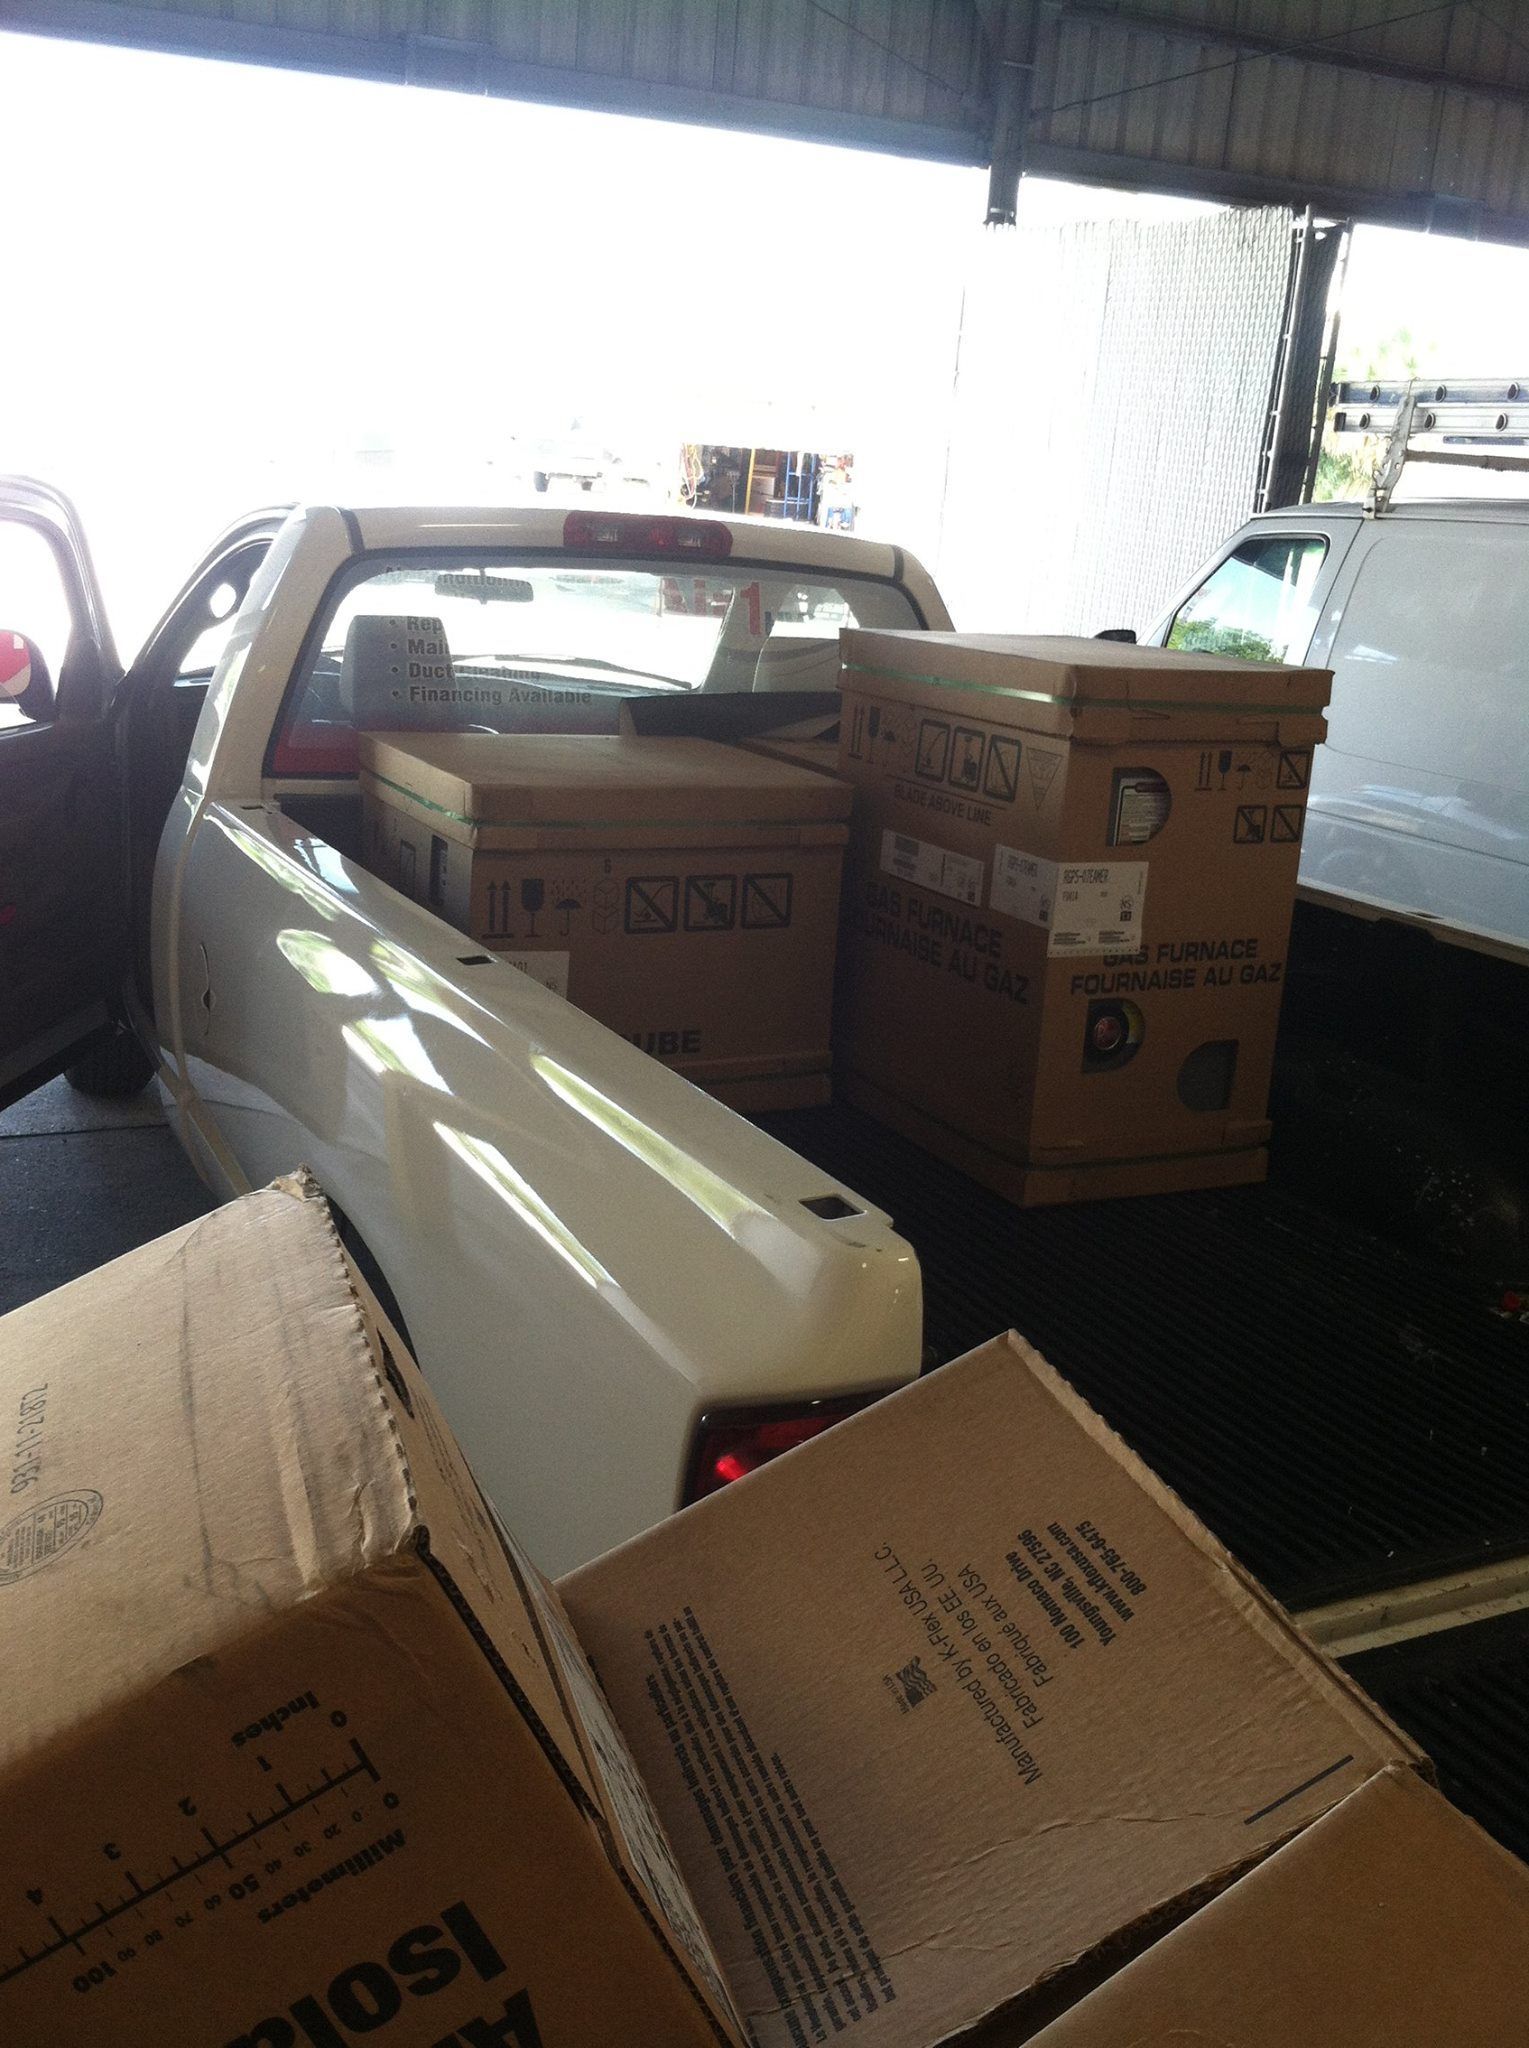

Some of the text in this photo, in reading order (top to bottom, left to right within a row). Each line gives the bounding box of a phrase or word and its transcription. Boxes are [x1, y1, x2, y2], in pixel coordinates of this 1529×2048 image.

[408, 663, 454, 679] Duct
[409, 686, 592, 706] Financing Available
[927, 794, 965, 817] ABOVE
[966, 806, 994, 827] LINE
[864, 880, 1003, 959] GAS FURNACE
[1156, 938, 1258, 964] FURNACE
[947, 948, 978, 983] AU
[983, 962, 1031, 1006] GAZ
[1071, 962, 1283, 995] FOURNAISE AU GAZ
[1045, 1520, 1135, 1623] www.kflexusa.com
[1074, 1518, 1147, 1597] 800-765-6475
[896, 1579, 929, 1617] USA
[1001, 1549, 1086, 1651] 100 Nomaco Drive
[1016, 1527, 1118, 1646] Youngsville, NC 27596
[916, 1611, 959, 1662] K-Flex
[916, 1556, 1044, 1729] Fabricado en los EE. UU.
[954, 1562, 1057, 1688] Fabriqué aux USA
[947, 1654, 977, 1683] by
[228, 1689, 320, 1754] Inches
[959, 1677, 1044, 1786] Manufactured
[24, 1709, 347, 1907] 0 1 2 3 4
[382, 1791, 400, 1809] 0
[292, 1840, 313, 1859] 30
[321, 1822, 342, 1842] 20
[255, 1827, 408, 1928] Millimeters
[262, 1856, 284, 1876] 40
[202, 1892, 223, 1912] 60
[226, 1872, 260, 1902] 50
[173, 1910, 194, 1929] 70
[115, 1944, 136, 1964] 90
[143, 1928, 163, 1947] 80
[69, 1958, 117, 1995] 100
